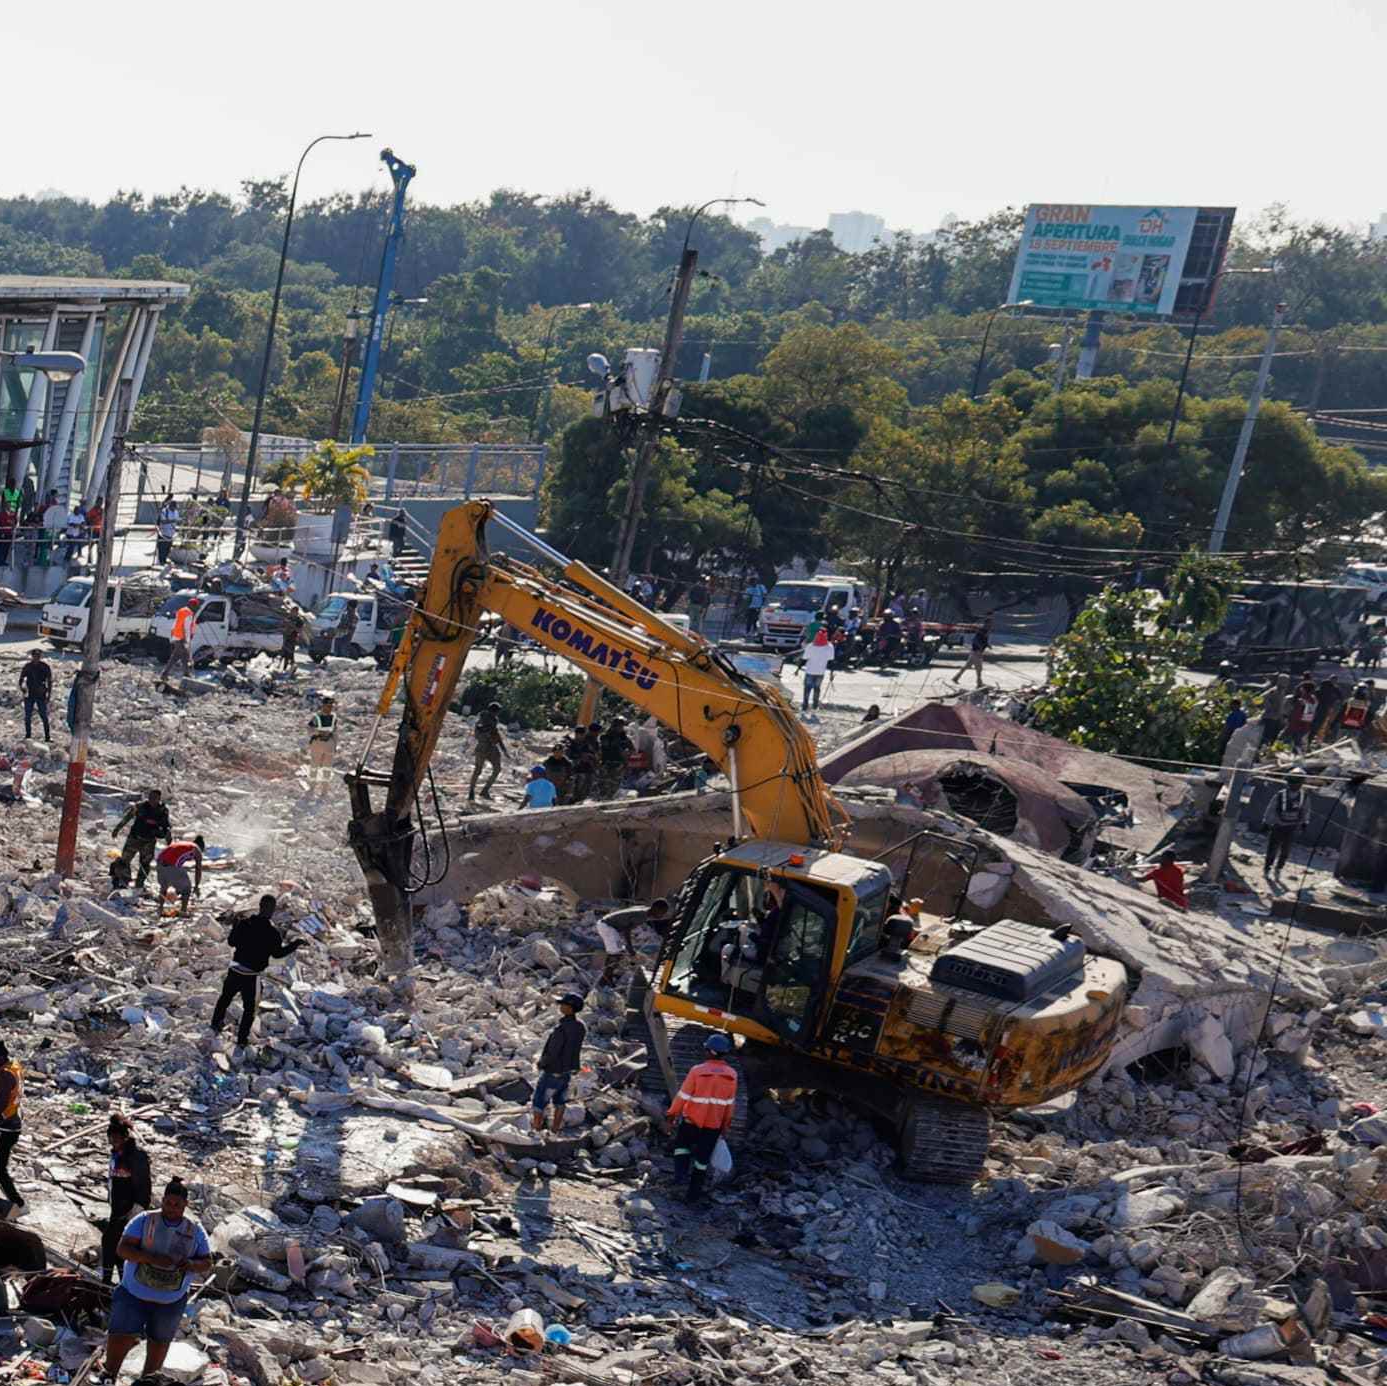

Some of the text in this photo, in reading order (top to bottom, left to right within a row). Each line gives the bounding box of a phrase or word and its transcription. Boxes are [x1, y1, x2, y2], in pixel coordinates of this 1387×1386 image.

[1035, 206, 1091, 224] GRAN
[1032, 223, 1122, 241] APERTURA
[530, 607, 659, 690] KOMATSU
